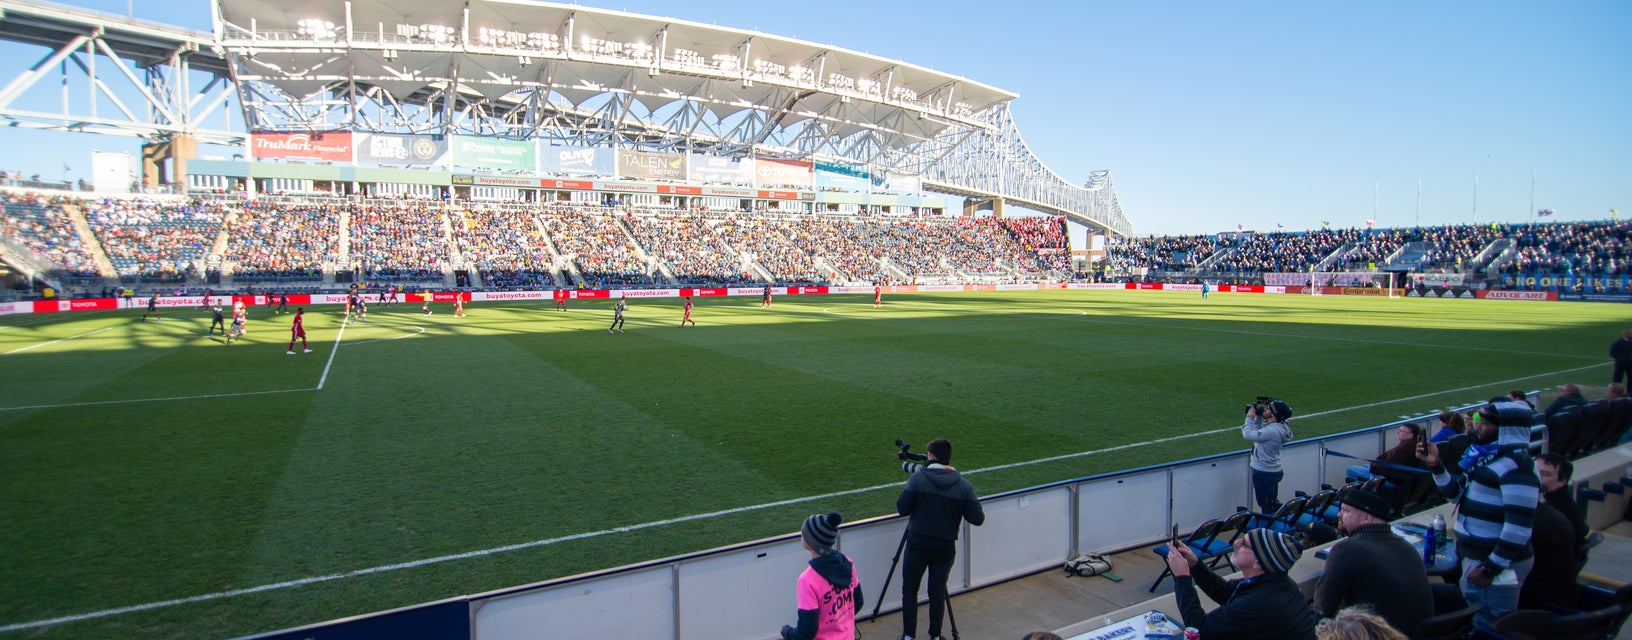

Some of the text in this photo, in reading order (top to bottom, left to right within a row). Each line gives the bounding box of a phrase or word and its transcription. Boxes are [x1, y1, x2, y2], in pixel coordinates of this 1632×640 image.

[256, 136, 311, 151] TruMark
[624, 154, 667, 169] TALEN
[773, 167, 809, 177] TOYOTA
[479, 177, 531, 185] buyatoyota.com
[603, 183, 648, 191] buyatoyota.com
[1516, 277, 1536, 286] NO
[1541, 277, 1571, 287] ONE
[1343, 287, 1380, 295] Continental
[1487, 291, 1546, 299] ADVOCARE
[486, 292, 542, 300] buyatoyota.com
